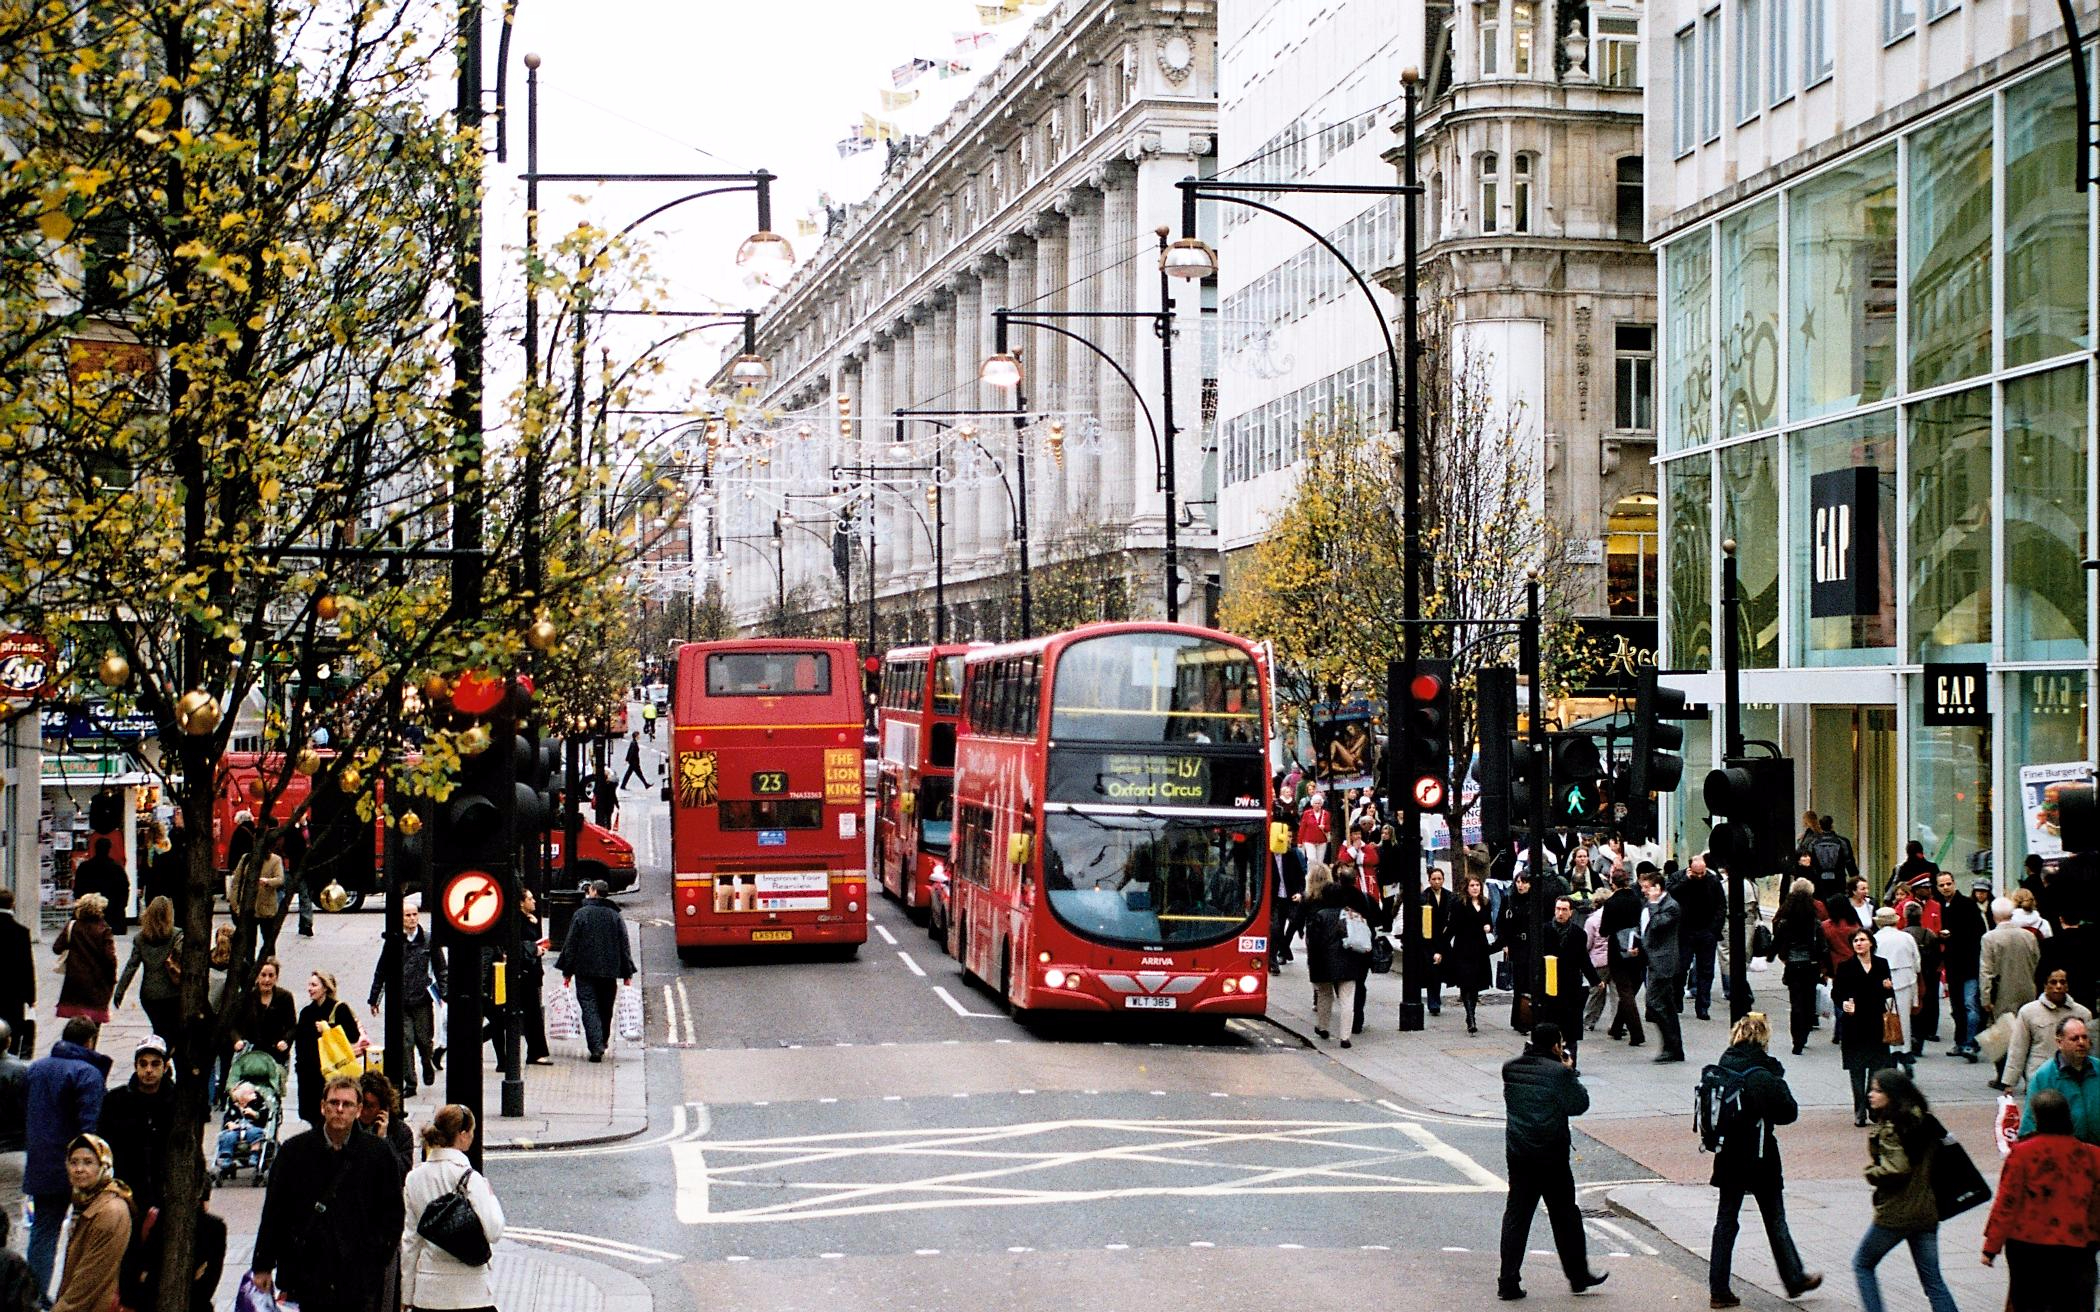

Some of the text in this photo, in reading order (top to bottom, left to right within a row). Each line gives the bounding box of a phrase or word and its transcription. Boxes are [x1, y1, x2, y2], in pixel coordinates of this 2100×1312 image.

[1816, 504, 1850, 583] GAP
[1937, 675, 1975, 705] GAP
[830, 754, 854, 765] THE
[1179, 757, 1202, 778] 137
[2024, 770, 2043, 778] Fine
[2044, 768, 2077, 778] Burger
[826, 768, 860, 780] LION
[758, 774, 782, 792] 23
[826, 783, 861, 795] KING
[1109, 782, 1202, 797] Oxford Circus
[1141, 957, 1174, 966] ARRIVA
[1132, 997, 1170, 1007] WLT 385
